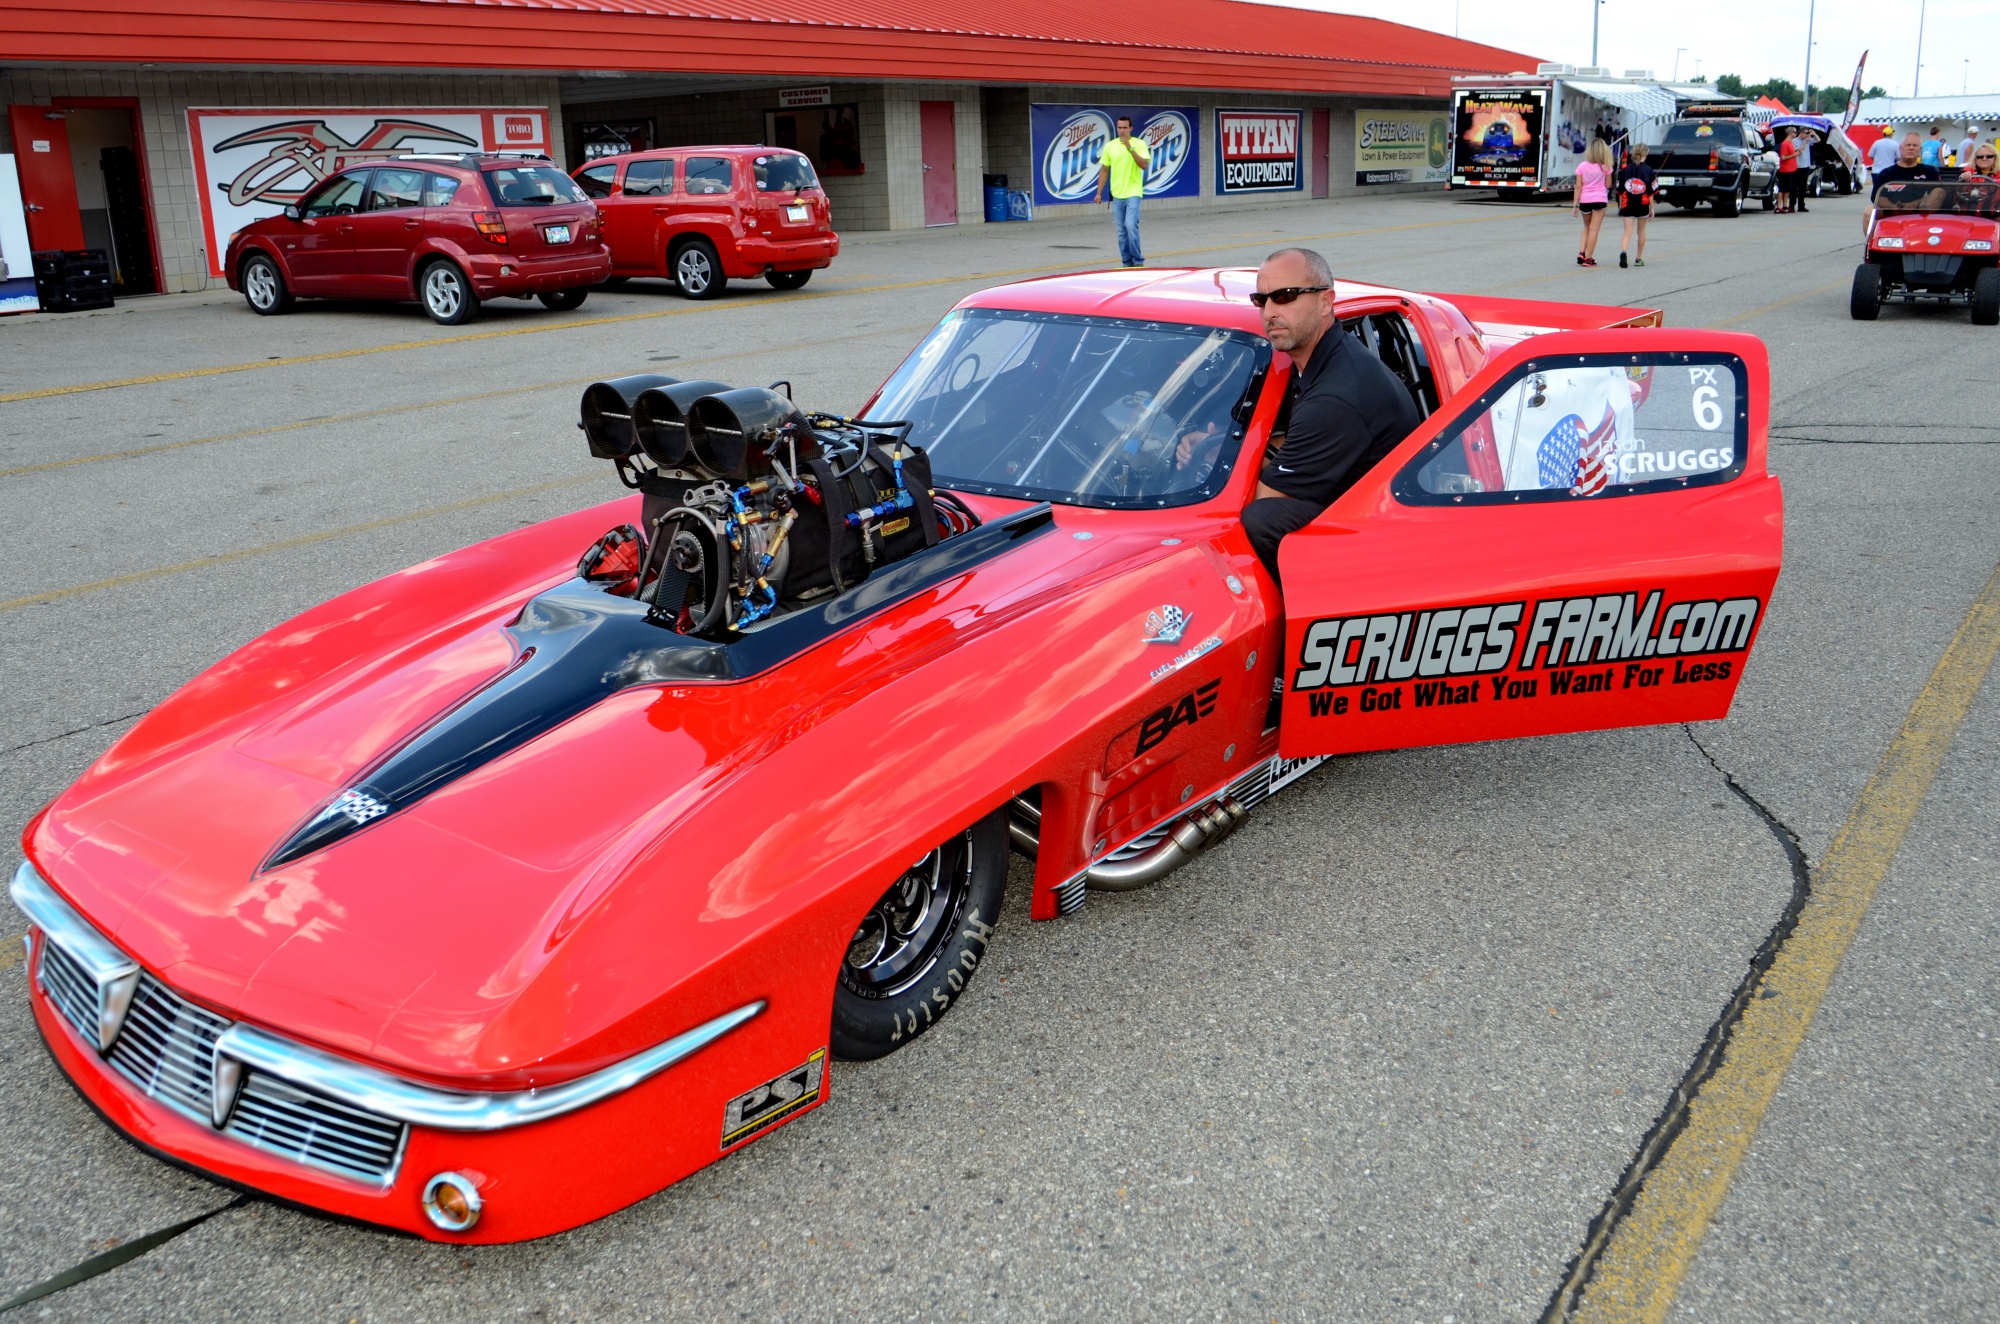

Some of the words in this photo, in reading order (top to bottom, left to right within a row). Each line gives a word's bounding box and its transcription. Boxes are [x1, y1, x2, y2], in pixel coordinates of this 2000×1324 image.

[781, 88, 828, 98] CUSTOMER
[787, 97, 824, 105] SERVICE
[1465, 100, 1494, 114] HEAT
[1500, 101, 1534, 113] WAVE
[507, 124, 531, 134] TORO
[1064, 122, 1097, 146] Miller
[1146, 122, 1175, 146] Miller
[1224, 119, 1295, 154] TITAN
[1360, 119, 1426, 148] STEENSMA
[1057, 134, 1105, 194] Lite
[1362, 151, 1376, 161] Lawn
[1377, 152, 1380, 160] &
[1382, 152, 1397, 160] Power
[1399, 151, 1425, 162] Equipment
[1226, 162, 1293, 186] EQUIPMENT
[1366, 173, 1389, 183] Kalamazoo
[920, 332, 949, 358] 6
[1688, 368, 1717, 385] PX
[1693, 386, 1722, 430] 6
[1604, 448, 1734, 475] SCRUGGS
[1292, 601, 1526, 691] SCRUGGS
[1518, 590, 1760, 670] FARM.com
[1150, 664, 1172, 680] FUEL
[1174, 635, 1220, 665] INJECTION
[1309, 692, 1348, 717] We
[1360, 687, 1402, 712] Got
[1414, 680, 1480, 707] What
[1492, 676, 1537, 700] You
[1550, 669, 1614, 695] Want
[1622, 664, 1664, 688] For
[1672, 660, 1732, 684] Less
[840, 974, 887, 998] FORGE
[724, 1056, 824, 1138] PSI
